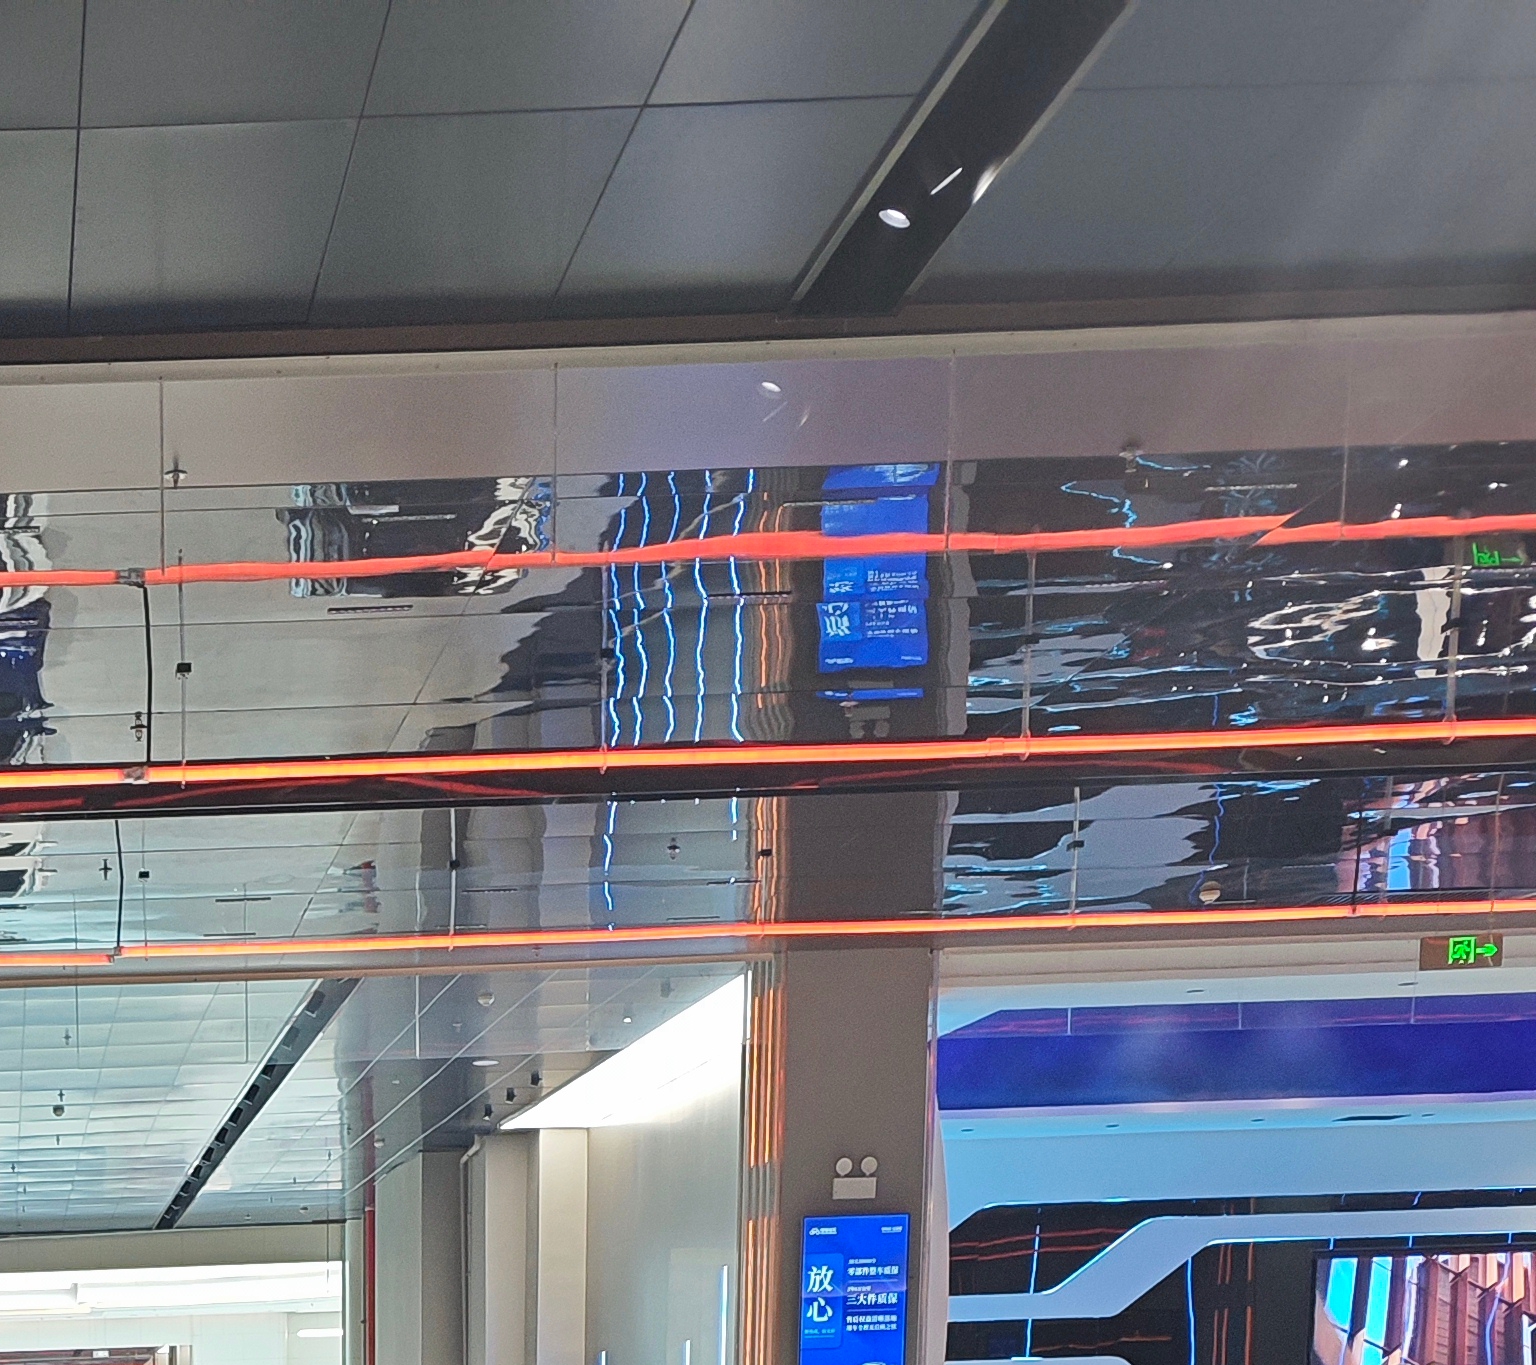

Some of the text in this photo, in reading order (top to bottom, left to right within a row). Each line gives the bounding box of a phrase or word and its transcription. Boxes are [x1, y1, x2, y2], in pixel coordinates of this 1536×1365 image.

[807, 1266, 834, 1323] 放心
[846, 1292, 898, 1306] 三大件质保
